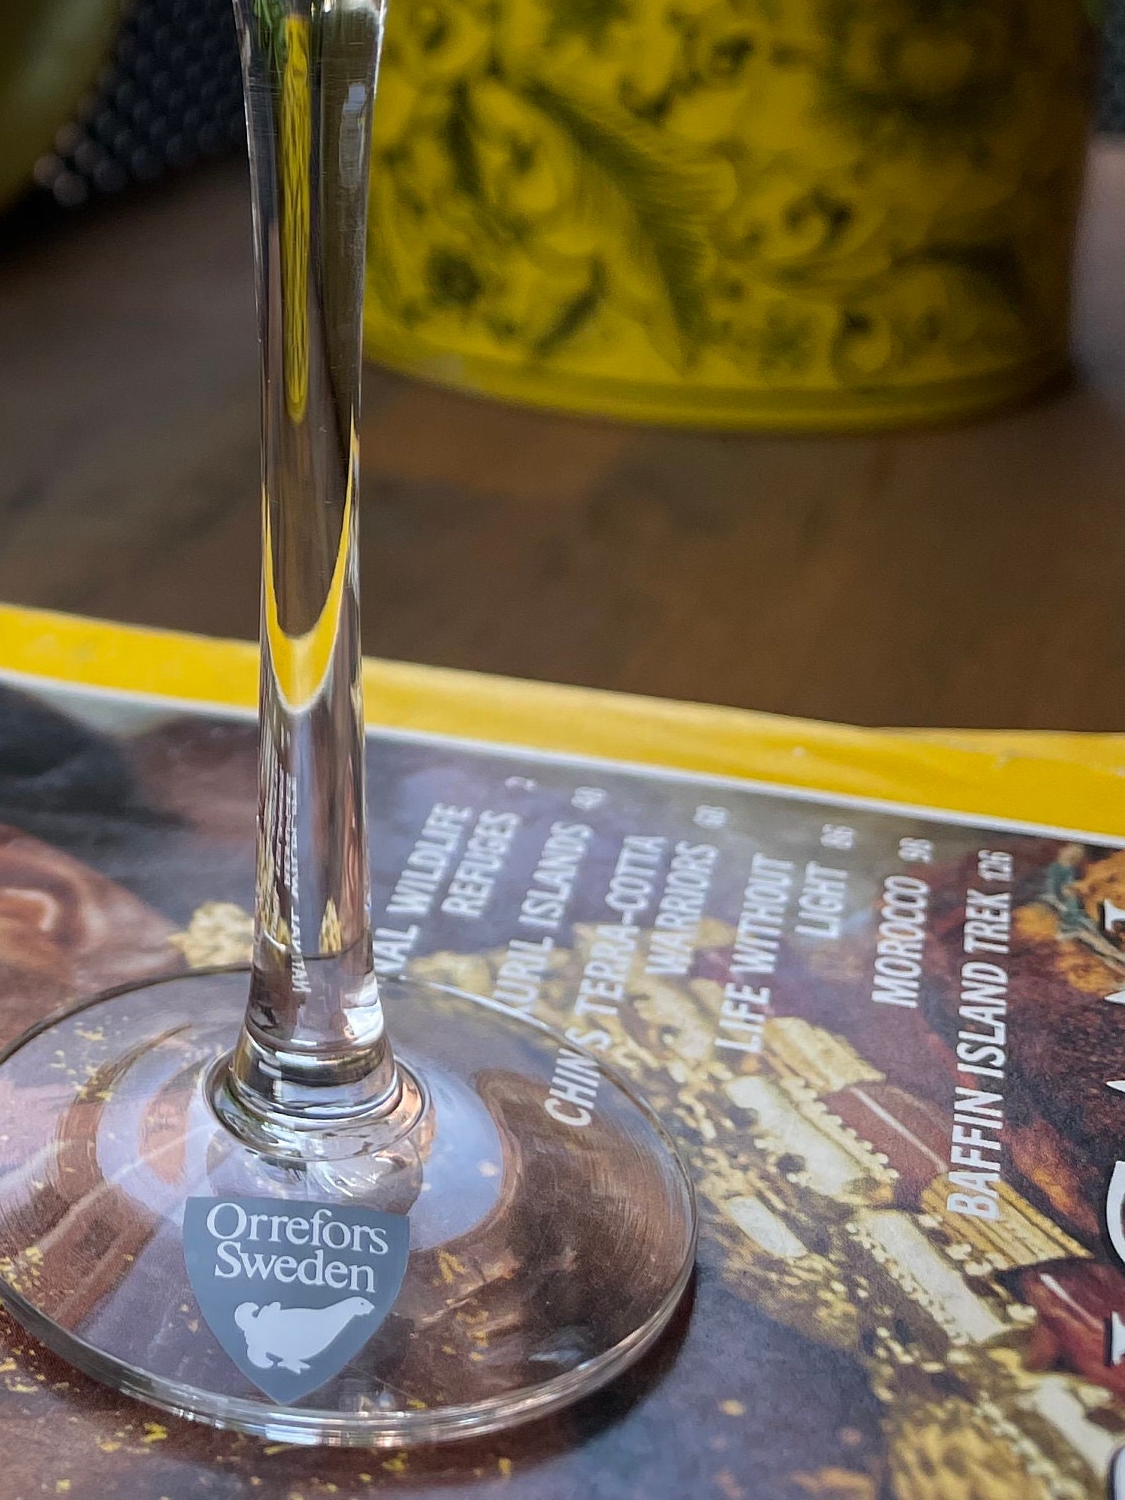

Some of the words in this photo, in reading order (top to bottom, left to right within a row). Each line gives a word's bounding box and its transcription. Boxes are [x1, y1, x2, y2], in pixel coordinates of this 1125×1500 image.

[385, 802, 473, 916] WILDLIFE
[441, 810, 520, 918] REFUGES
[518, 820, 594, 929] ISLANDS
[644, 839, 719, 976] WARRIORS
[729, 851, 797, 975] WITHOUT
[794, 860, 849, 940] LIGHT
[977, 849, 1013, 883] 126
[575, 835, 668, 1016] TERRA-COTTA
[871, 875, 930, 1009] MOROCCO
[963, 888, 1012, 954] TREK
[715, 982, 771, 1054] LIFE
[956, 961, 1008, 1079] ISLAND
[947, 1086, 1005, 1222] BAFFIN
[206, 1202, 389, 1256] Orrefors
[214, 1240, 377, 1293] Sweden
